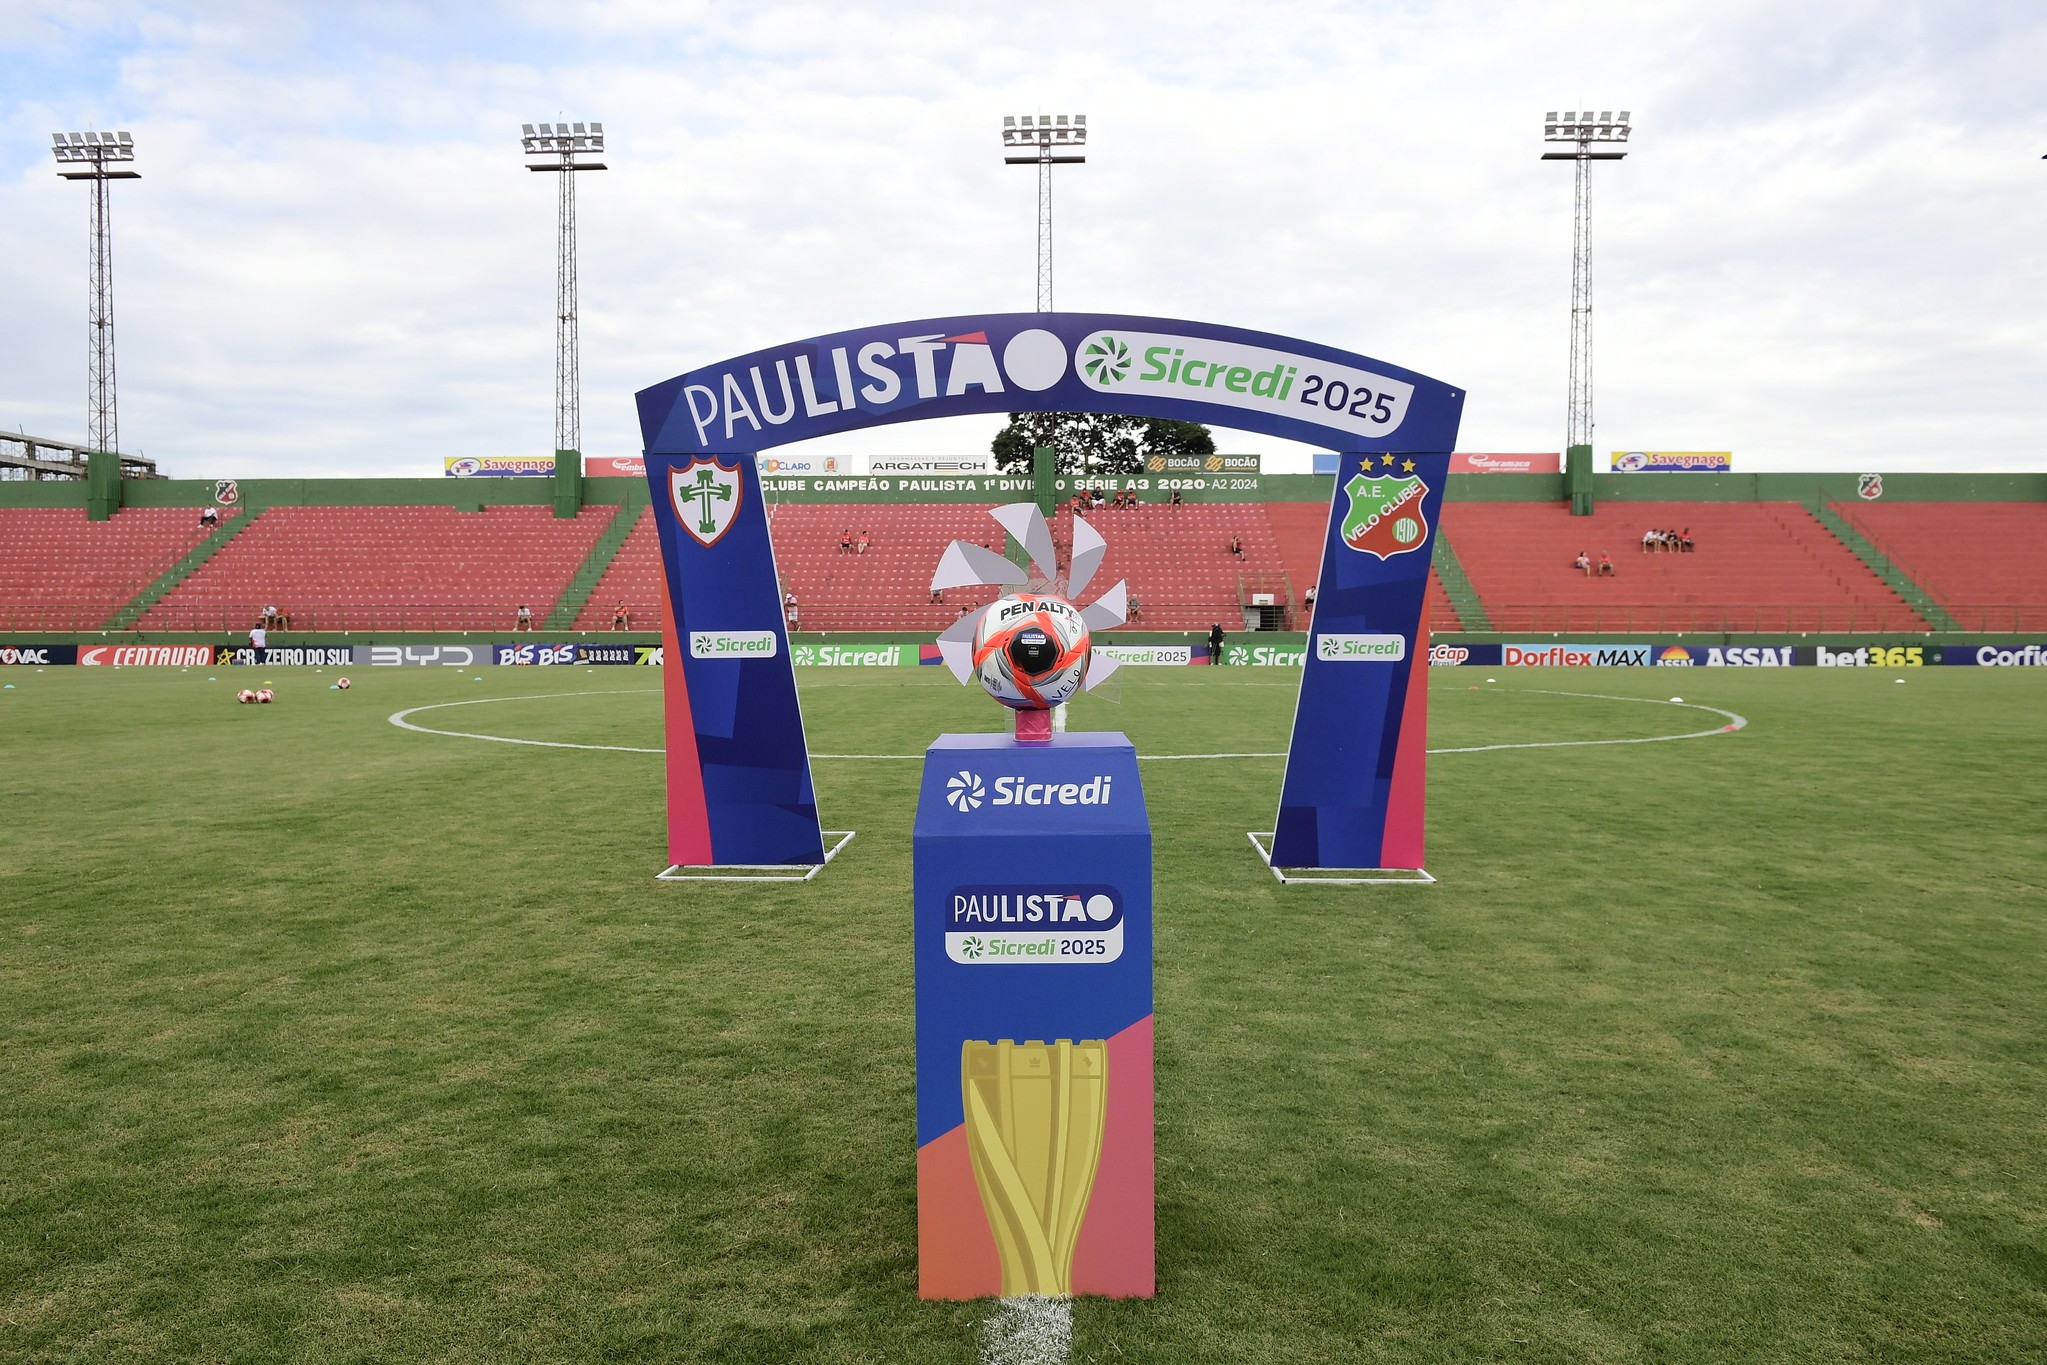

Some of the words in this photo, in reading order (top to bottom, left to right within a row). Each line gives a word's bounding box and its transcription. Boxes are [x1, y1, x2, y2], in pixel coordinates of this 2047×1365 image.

[1139, 346, 1297, 401] Sicredi
[1300, 374, 1396, 424] 2025
[484, 459, 555, 473] Savegnago
[779, 462, 811, 471] CLARO
[872, 462, 986, 470] ARGATECH
[1168, 457, 1200, 467] BOCÃO
[1225, 457, 1257, 467] BOCÃO
[1652, 454, 1725, 468] Savegnago
[762, 480, 805, 491] CLUBE
[814, 477, 890, 491] CAMPEÃO
[899, 480, 976, 491] PAULISTA
[999, 479, 1066, 491] DIVIO
[1074, 475, 1117, 490] SÉRIE
[1126, 478, 1149, 489] A3
[1230, 478, 1258, 489] 2024
[1356, 485, 1385, 498] A.E.
[1346, 513, 1380, 542] VELO
[1380, 480, 1422, 517] CLUBE
[1396, 517, 1418, 543] 1910
[716, 637, 771, 652] Sicredi
[1343, 641, 1400, 655] Sicredi
[113, 647, 209, 665] CENTAURO
[236, 648, 304, 666] CRZEIRO
[306, 648, 325, 666] DO
[327, 648, 353, 666] SUL
[371, 646, 473, 666] BYD
[818, 646, 900, 666] Sicredi
[1157, 651, 1187, 662] 2025
[1505, 647, 1592, 666] Dorflex
[1596, 649, 1647, 666] MAX
[1816, 646, 1923, 667] bet365
[1052, 669, 1080, 698] VELO
[992, 775, 1112, 806] Sicredi
[988, 938, 1056, 956] Sicredi
[1060, 939, 1106, 955] 2025
